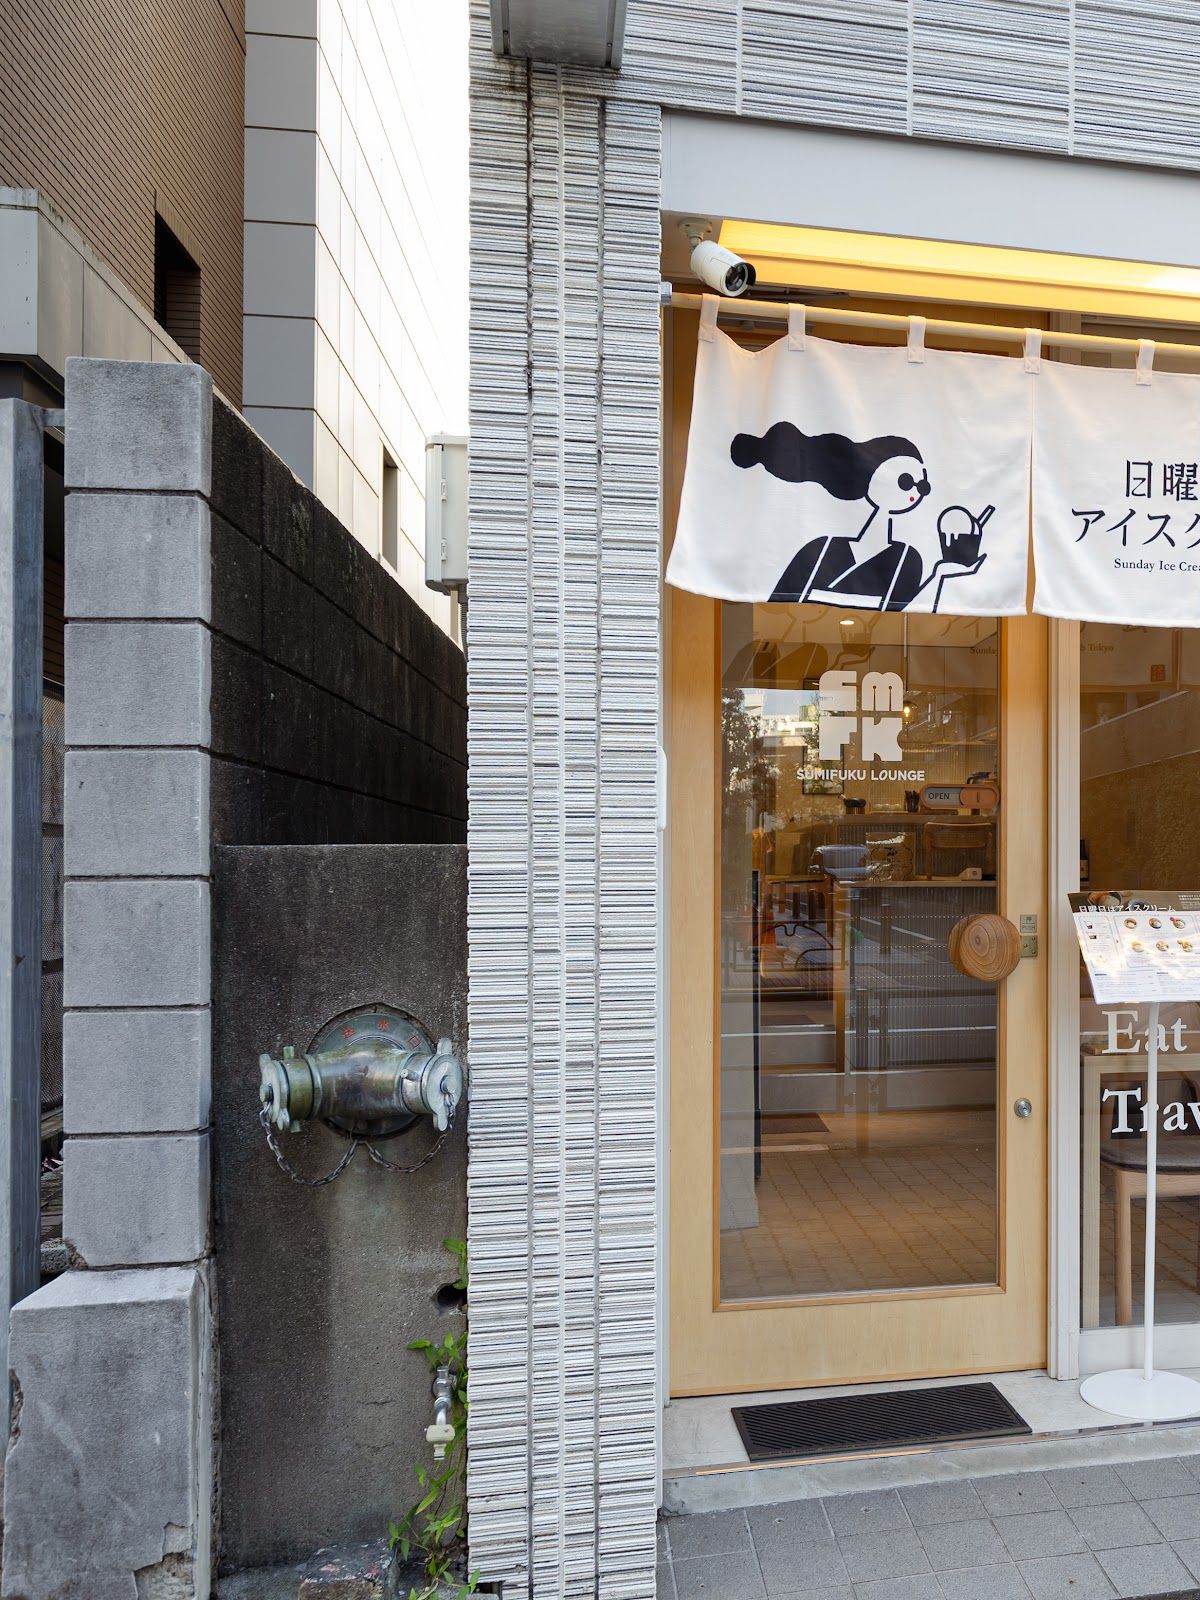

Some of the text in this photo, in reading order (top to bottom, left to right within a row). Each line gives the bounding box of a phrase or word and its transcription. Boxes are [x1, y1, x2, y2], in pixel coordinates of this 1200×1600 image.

[1114, 558, 1156, 571] Sunday
[1159, 560, 1176, 571] Ice
[796, 768, 925, 781] SUMIFUKU LOUNGE
[928, 791, 950, 800] OPEN
[1101, 1010, 1188, 1054] Eat
